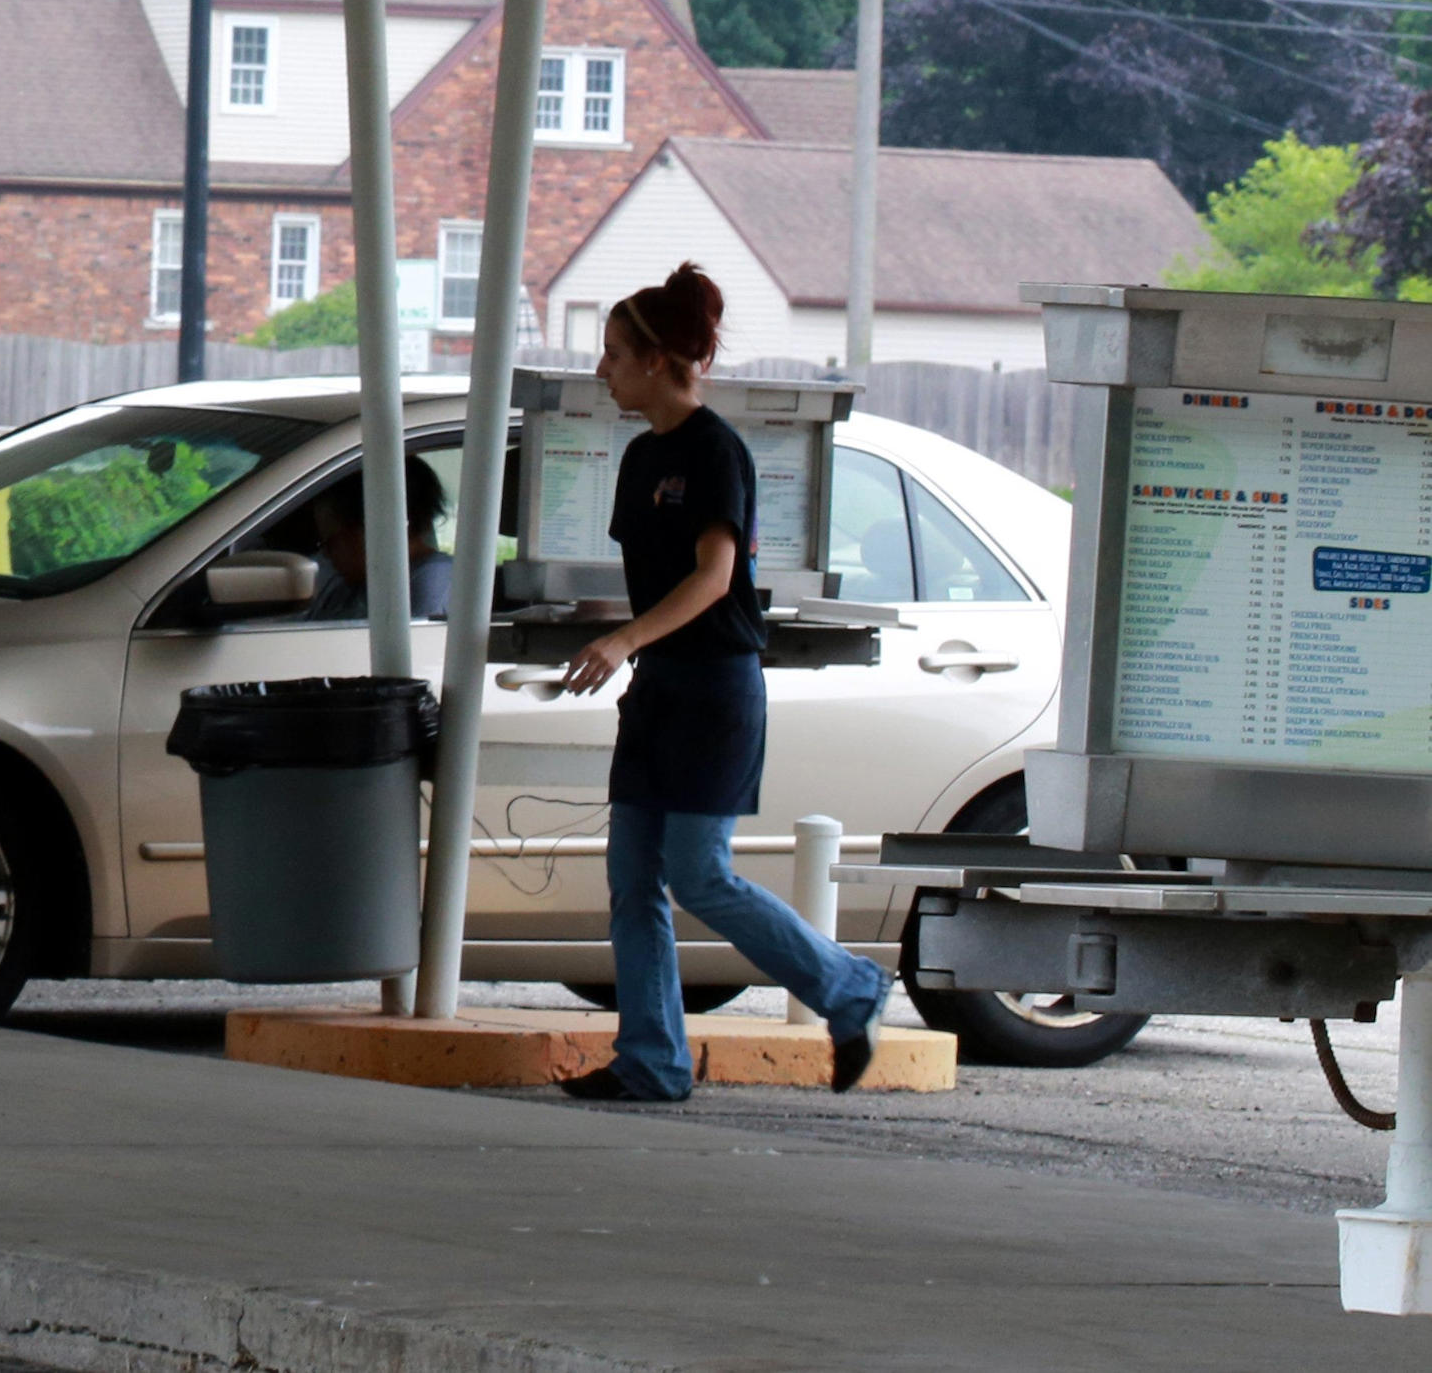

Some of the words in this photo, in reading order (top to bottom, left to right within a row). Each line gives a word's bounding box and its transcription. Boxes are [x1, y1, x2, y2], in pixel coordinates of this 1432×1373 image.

[1182, 393, 1249, 408] DINNERS
[1315, 401, 1383, 417] BURGERS
[1387, 405, 1399, 418] &
[1133, 484, 1231, 502] SANDWICHES
[1235, 490, 1247, 502] &
[1252, 490, 1289, 505] SUBS
[1349, 597, 1390, 610] SIDES
